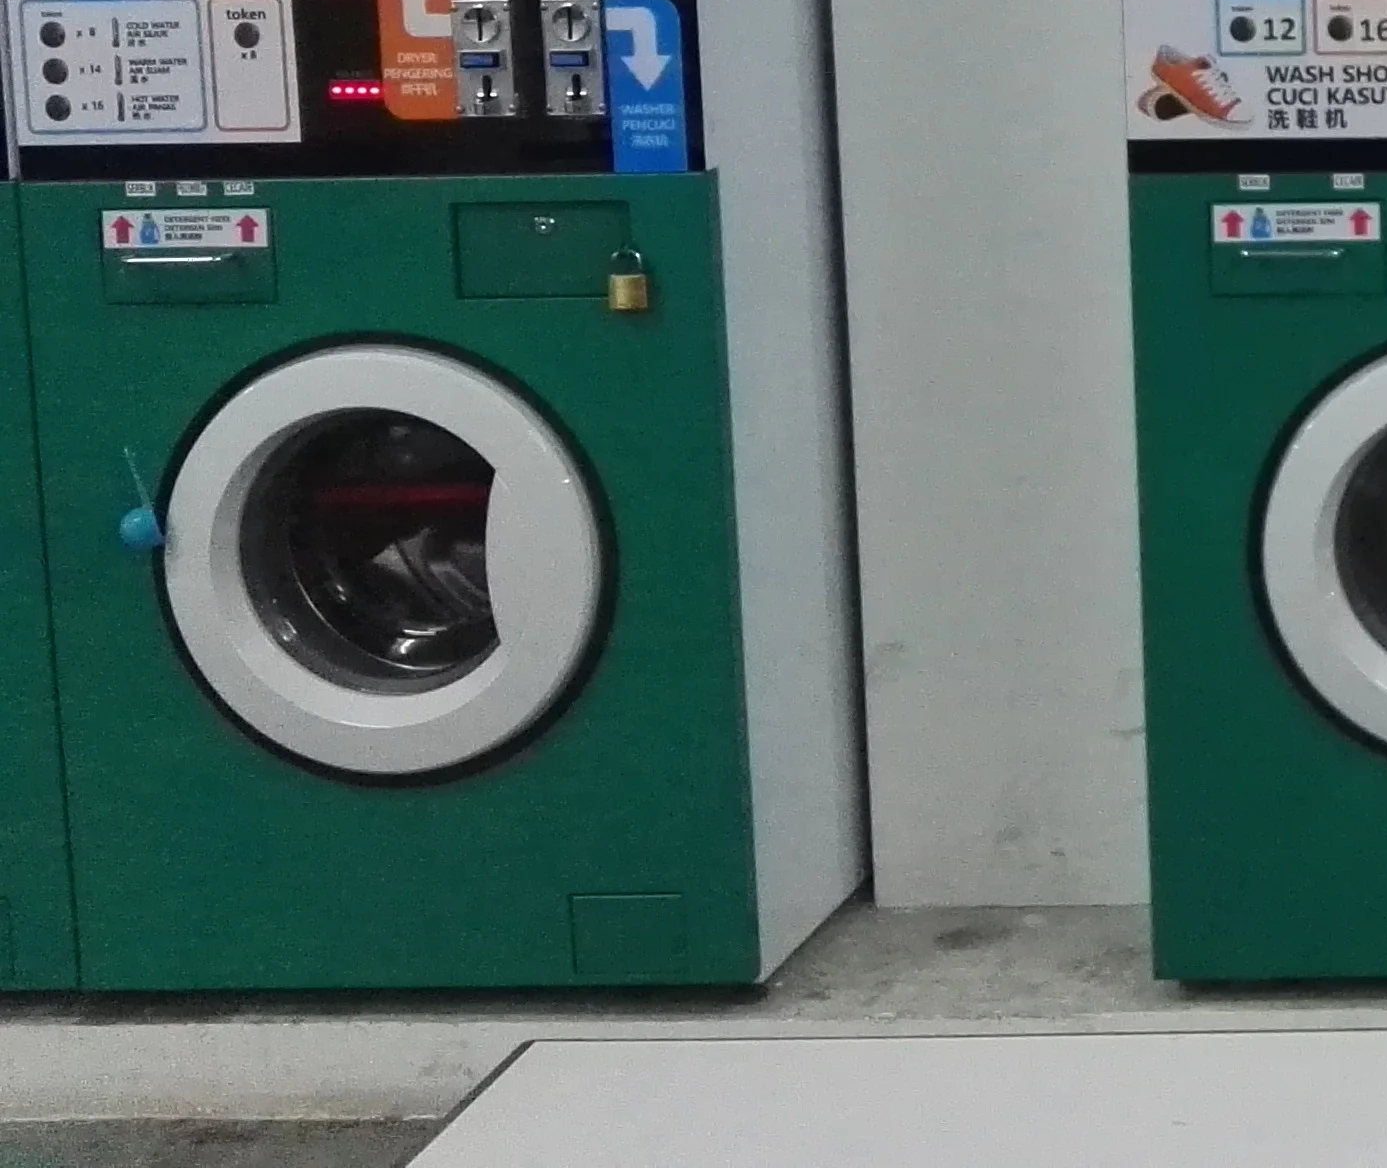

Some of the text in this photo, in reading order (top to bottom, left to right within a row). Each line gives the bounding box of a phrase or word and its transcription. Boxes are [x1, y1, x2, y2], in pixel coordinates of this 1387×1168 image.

[226, 8, 266, 20] token
[1263, 18, 1297, 42] 12
[397, 52, 437, 64] DRYER
[90, 64, 102, 74] 14
[383, 67, 453, 80] PENGERING
[1265, 65, 1335, 84] WASH
[1267, 87, 1320, 106] CUCI
